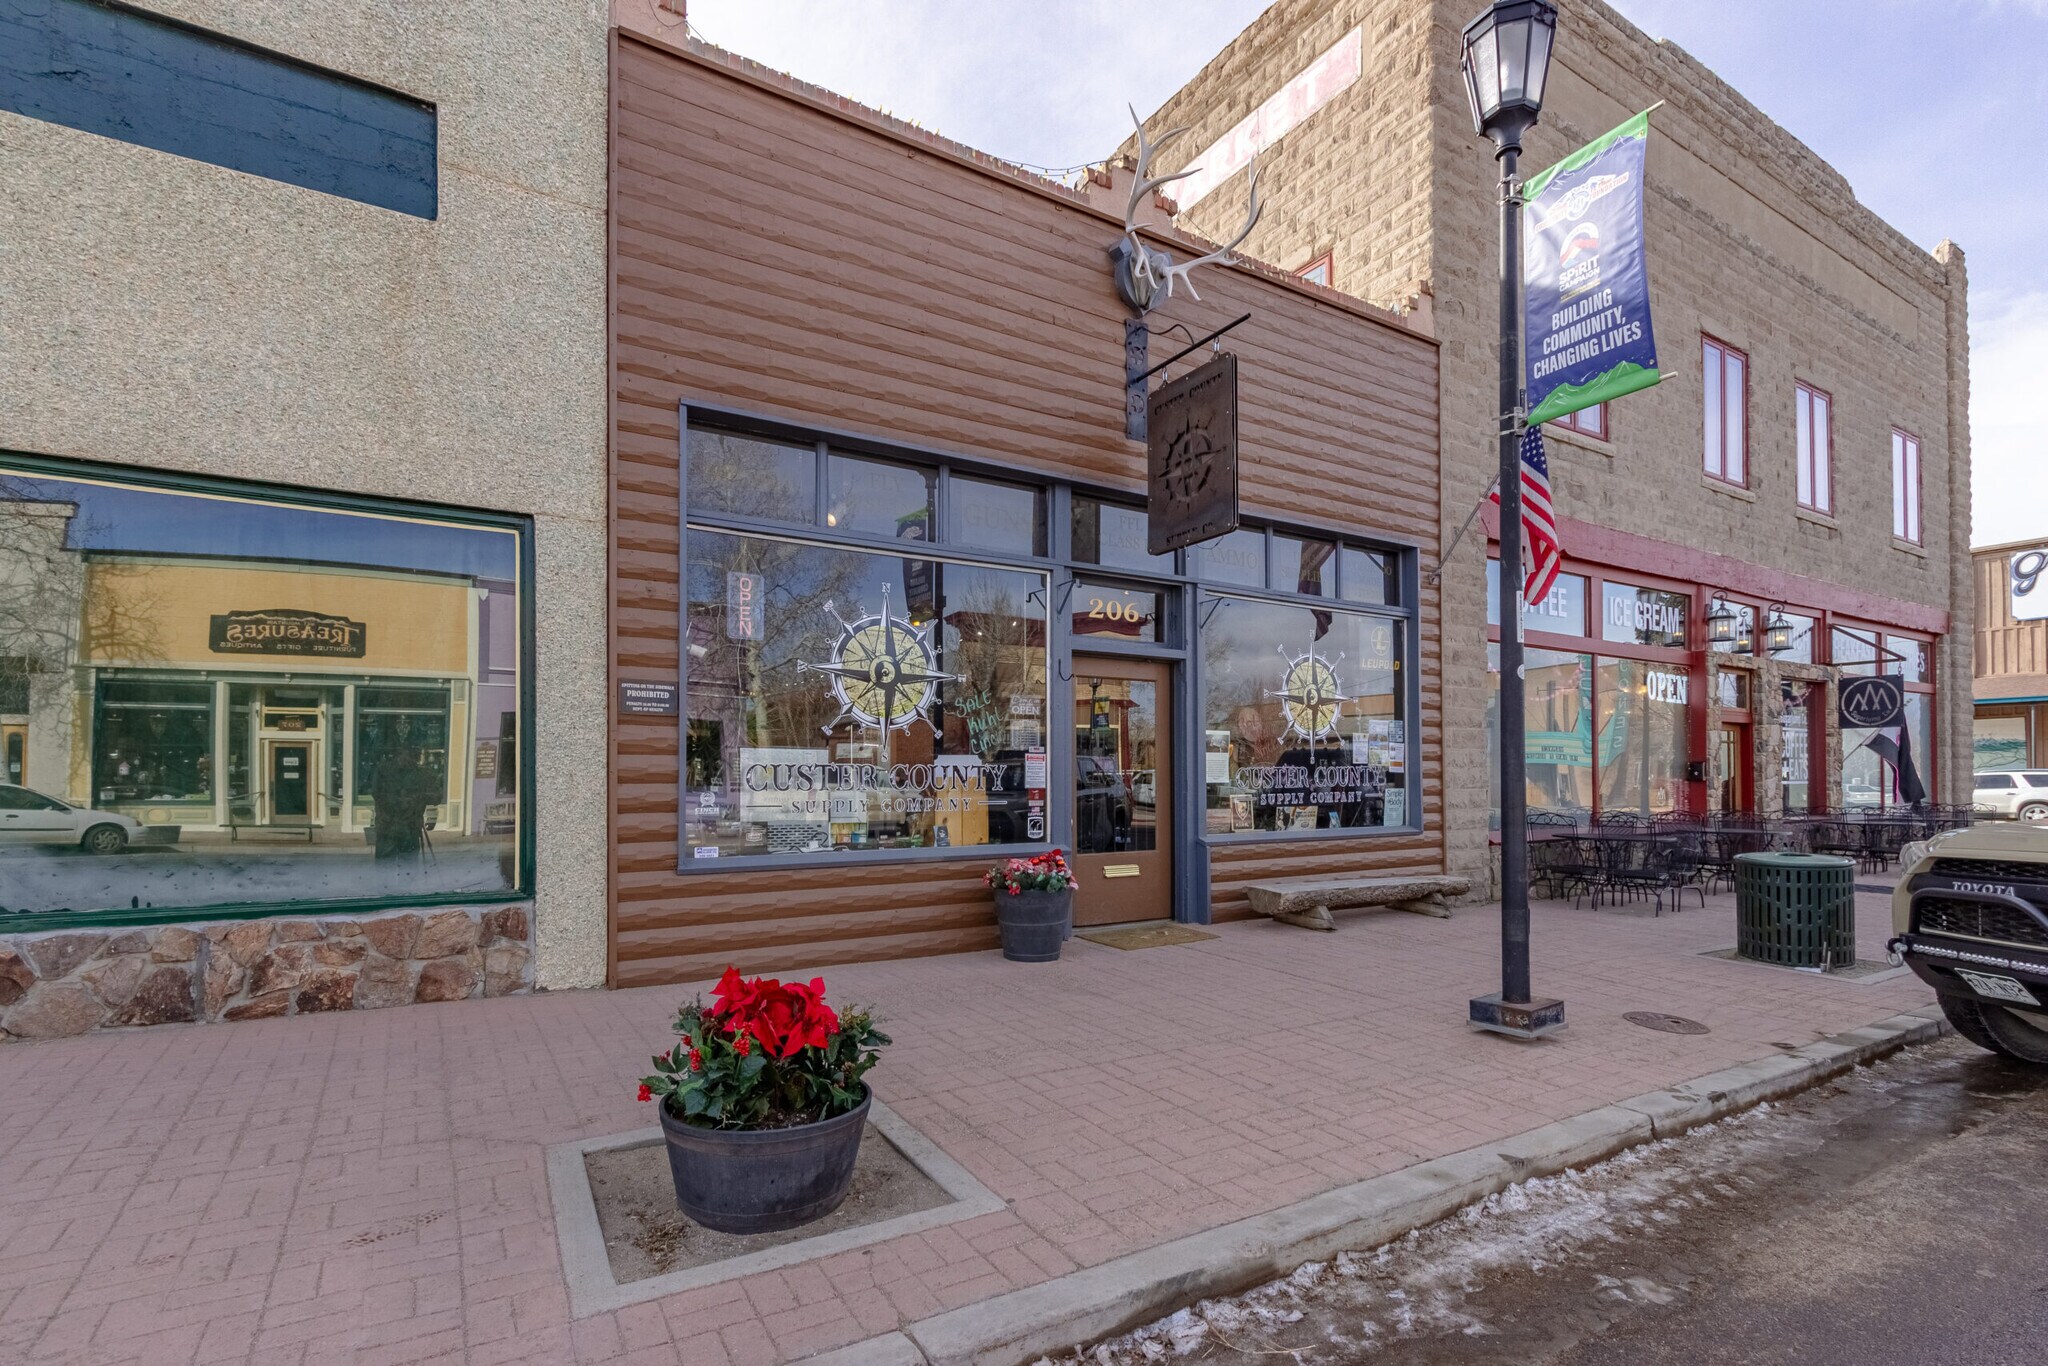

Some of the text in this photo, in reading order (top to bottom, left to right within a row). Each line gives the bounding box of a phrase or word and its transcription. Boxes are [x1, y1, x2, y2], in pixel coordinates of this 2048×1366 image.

[1559, 267, 1600, 291] CAMPAIGN
[1552, 288, 1613, 331] BUILDING
[1543, 305, 1626, 355] COMMUNITY,
[1534, 321, 1642, 379] CHANGING LIVES
[1205, 546, 1258, 570] AMMO
[882, 582, 891, 593] N
[740, 577, 751, 638] OPEN
[1089, 598, 1140, 623] 206
[1609, 596, 1680, 633] ICE CREAM
[1362, 659, 1400, 671] LEUPOLD
[627, 690, 670, 698] PROHIBITED
[1647, 671, 1689, 705] OPEN
[955, 688, 992, 717] SALE
[1011, 705, 1040, 715] OPEN
[746, 762, 879, 792] CUSTER
[888, 763, 1007, 792] COUNTY
[1236, 764, 1310, 789] CUSTER
[1314, 765, 1381, 787] COUNTY
[791, 798, 972, 814] SUPPLY COMPANY
[1260, 791, 1363, 806] SUPPLY COMPANY
[1952, 881, 2016, 897] TOYOTA
